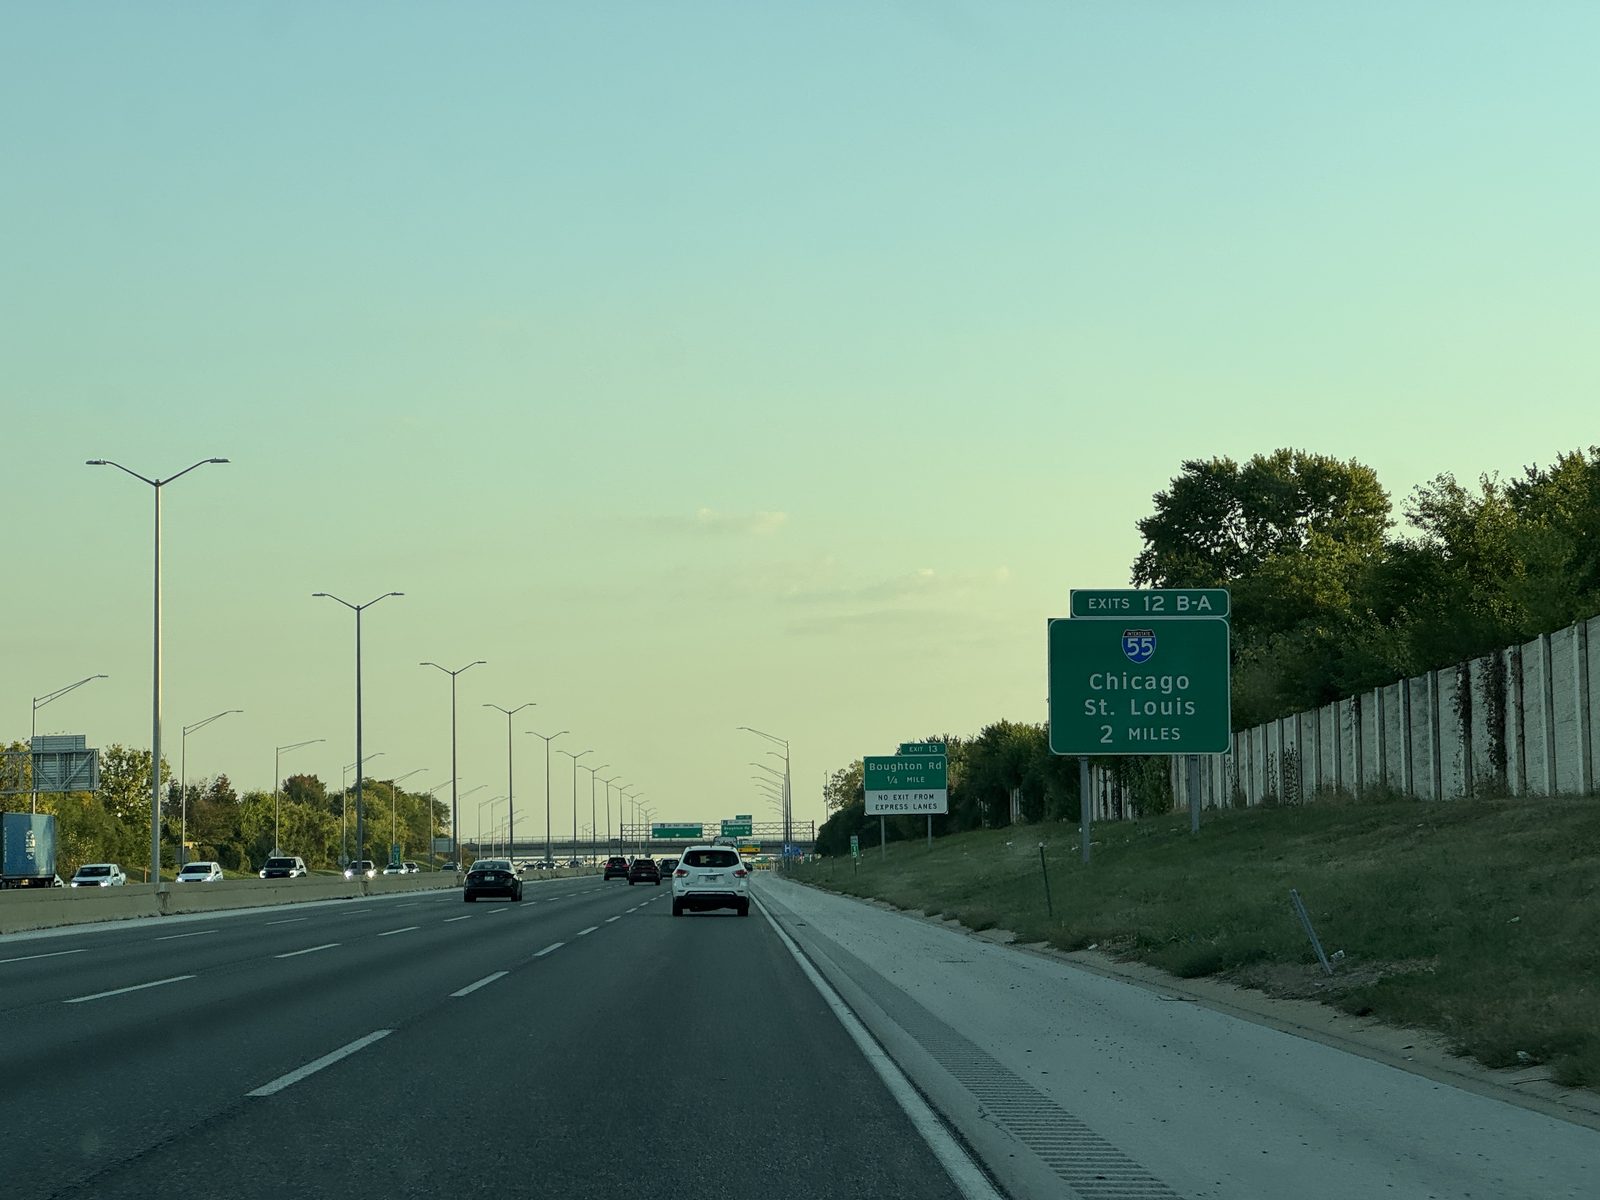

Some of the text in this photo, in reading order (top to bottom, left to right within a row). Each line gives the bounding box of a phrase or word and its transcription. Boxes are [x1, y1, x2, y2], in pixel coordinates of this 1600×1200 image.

[1088, 595, 1212, 611] EXITS 12 B-A
[1127, 637, 1153, 656] 55
[1089, 672, 1190, 694] Chicago
[1084, 698, 1196, 716] St. Louis
[1100, 725, 1181, 743] 2 MILES
[928, 745, 938, 753] 13
[869, 761, 942, 772] Boughton Rd
[875, 803, 909, 811] EXPRESS
